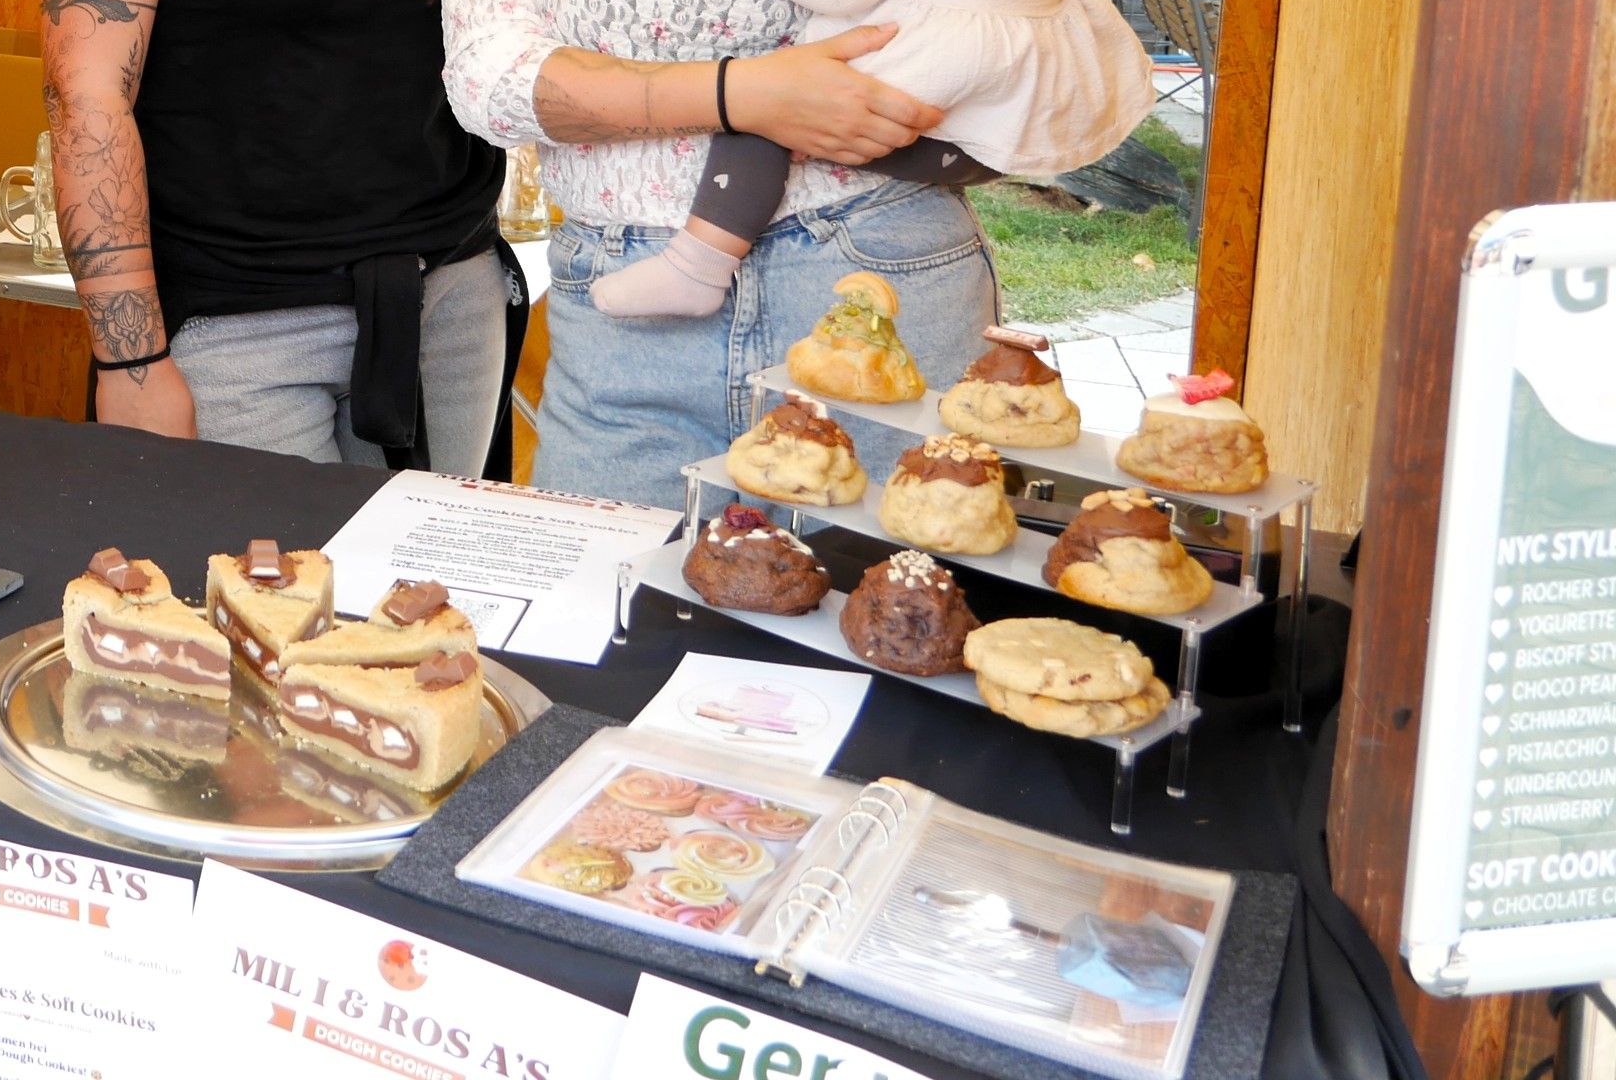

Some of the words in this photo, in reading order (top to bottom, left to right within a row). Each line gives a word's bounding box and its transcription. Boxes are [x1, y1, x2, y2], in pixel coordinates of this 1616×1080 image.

[1496, 534, 1547, 566] NYC
[1521, 579, 1594, 605] ROCHER
[1516, 608, 1615, 637] YOGURETTE
[1514, 645, 1585, 669] BISCOFF
[1511, 676, 1576, 702] CHOCO
[1506, 736, 1609, 765] PISTACCHIO
[1499, 796, 1615, 827] STRAWBERRY
[1467, 856, 1537, 891] SOFT
[2, 887, 70, 916] COOKIES
[1492, 886, 1597, 917] CHOCOLATE
[22, 989, 37, 1005] &
[41, 992, 76, 1015] Soft
[80, 1001, 157, 1033] Cookies
[337, 988, 369, 1019] &
[29, 1039, 48, 1054] bei
[313, 1023, 377, 1061] DOUGH
[37, 1054, 88, 1077] Cookies!
